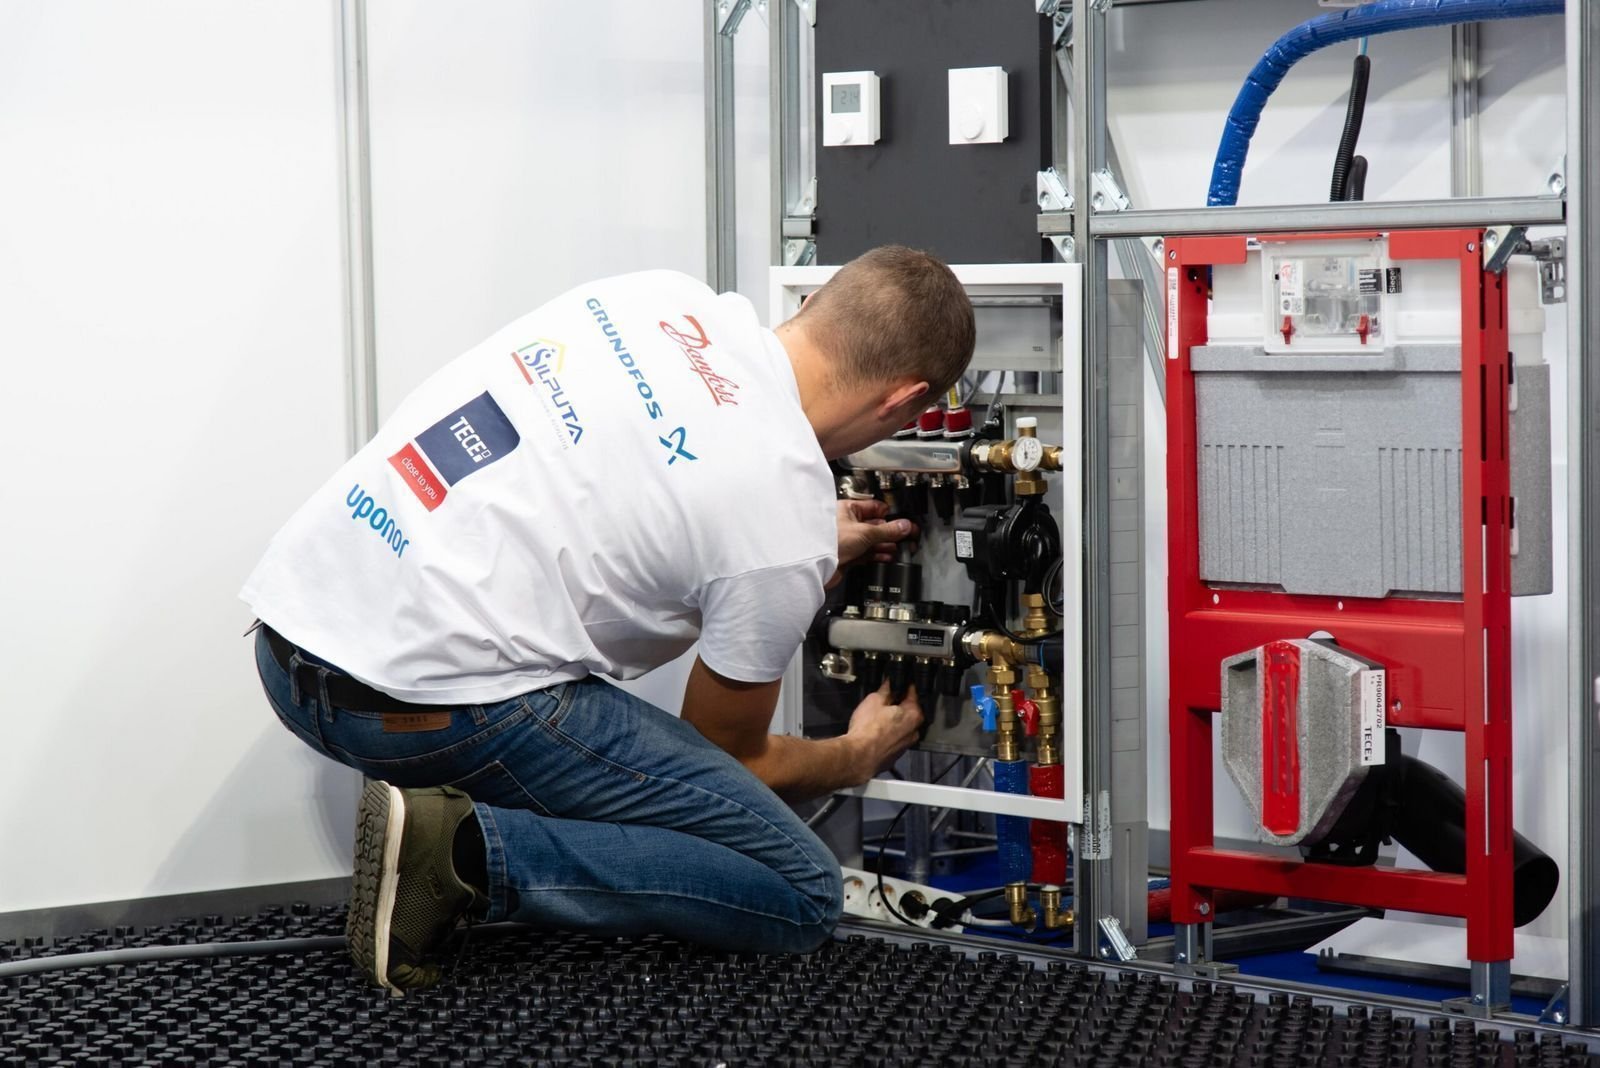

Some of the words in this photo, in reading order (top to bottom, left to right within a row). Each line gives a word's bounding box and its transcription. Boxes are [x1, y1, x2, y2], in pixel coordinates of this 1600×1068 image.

[586, 297, 664, 420] GRUNDFOS
[658, 314, 740, 407] Danfoss
[449, 415, 485, 460] TECE
[401, 457, 419, 477] close
[423, 484, 438, 500] you
[347, 483, 410, 558] uponor
[1364, 726, 1374, 757] TECE
